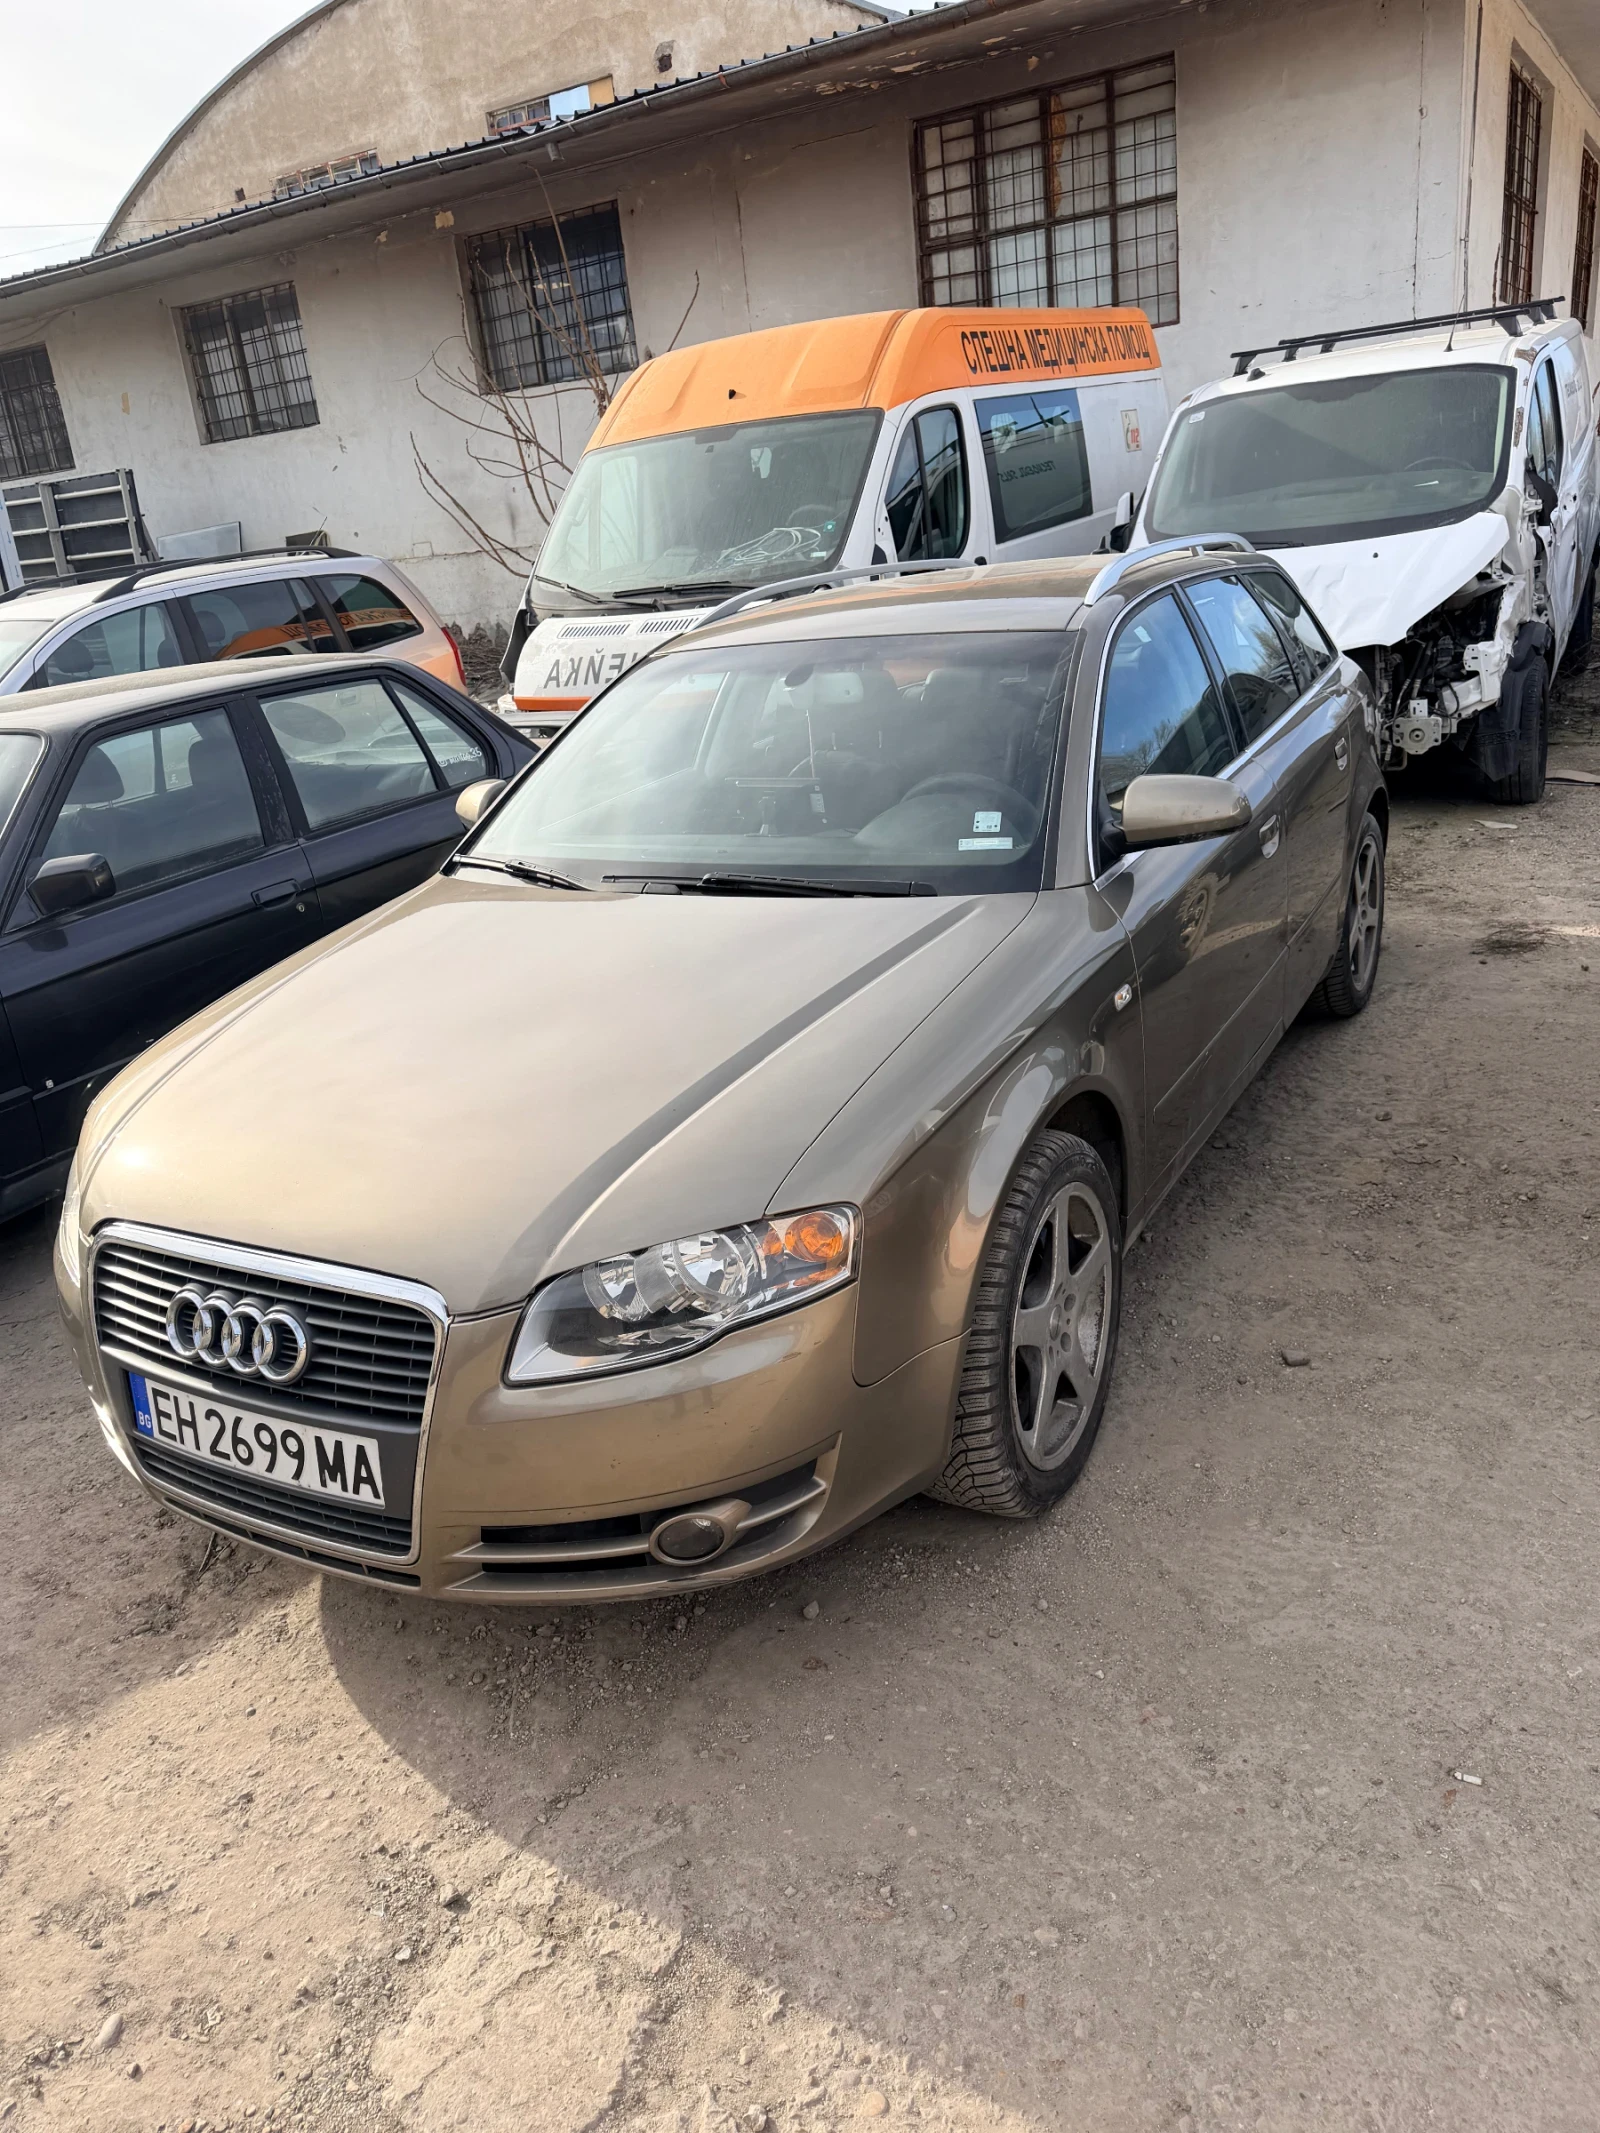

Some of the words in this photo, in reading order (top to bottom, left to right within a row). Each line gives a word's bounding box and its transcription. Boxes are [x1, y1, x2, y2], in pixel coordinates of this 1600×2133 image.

[961, 330, 1030, 374] СПЕШНА
[1024, 326, 1111, 375] МЕДИЦИНСКА
[1106, 324, 1152, 364] ПОМОЩ
[138, 1410, 152, 1429] BG
